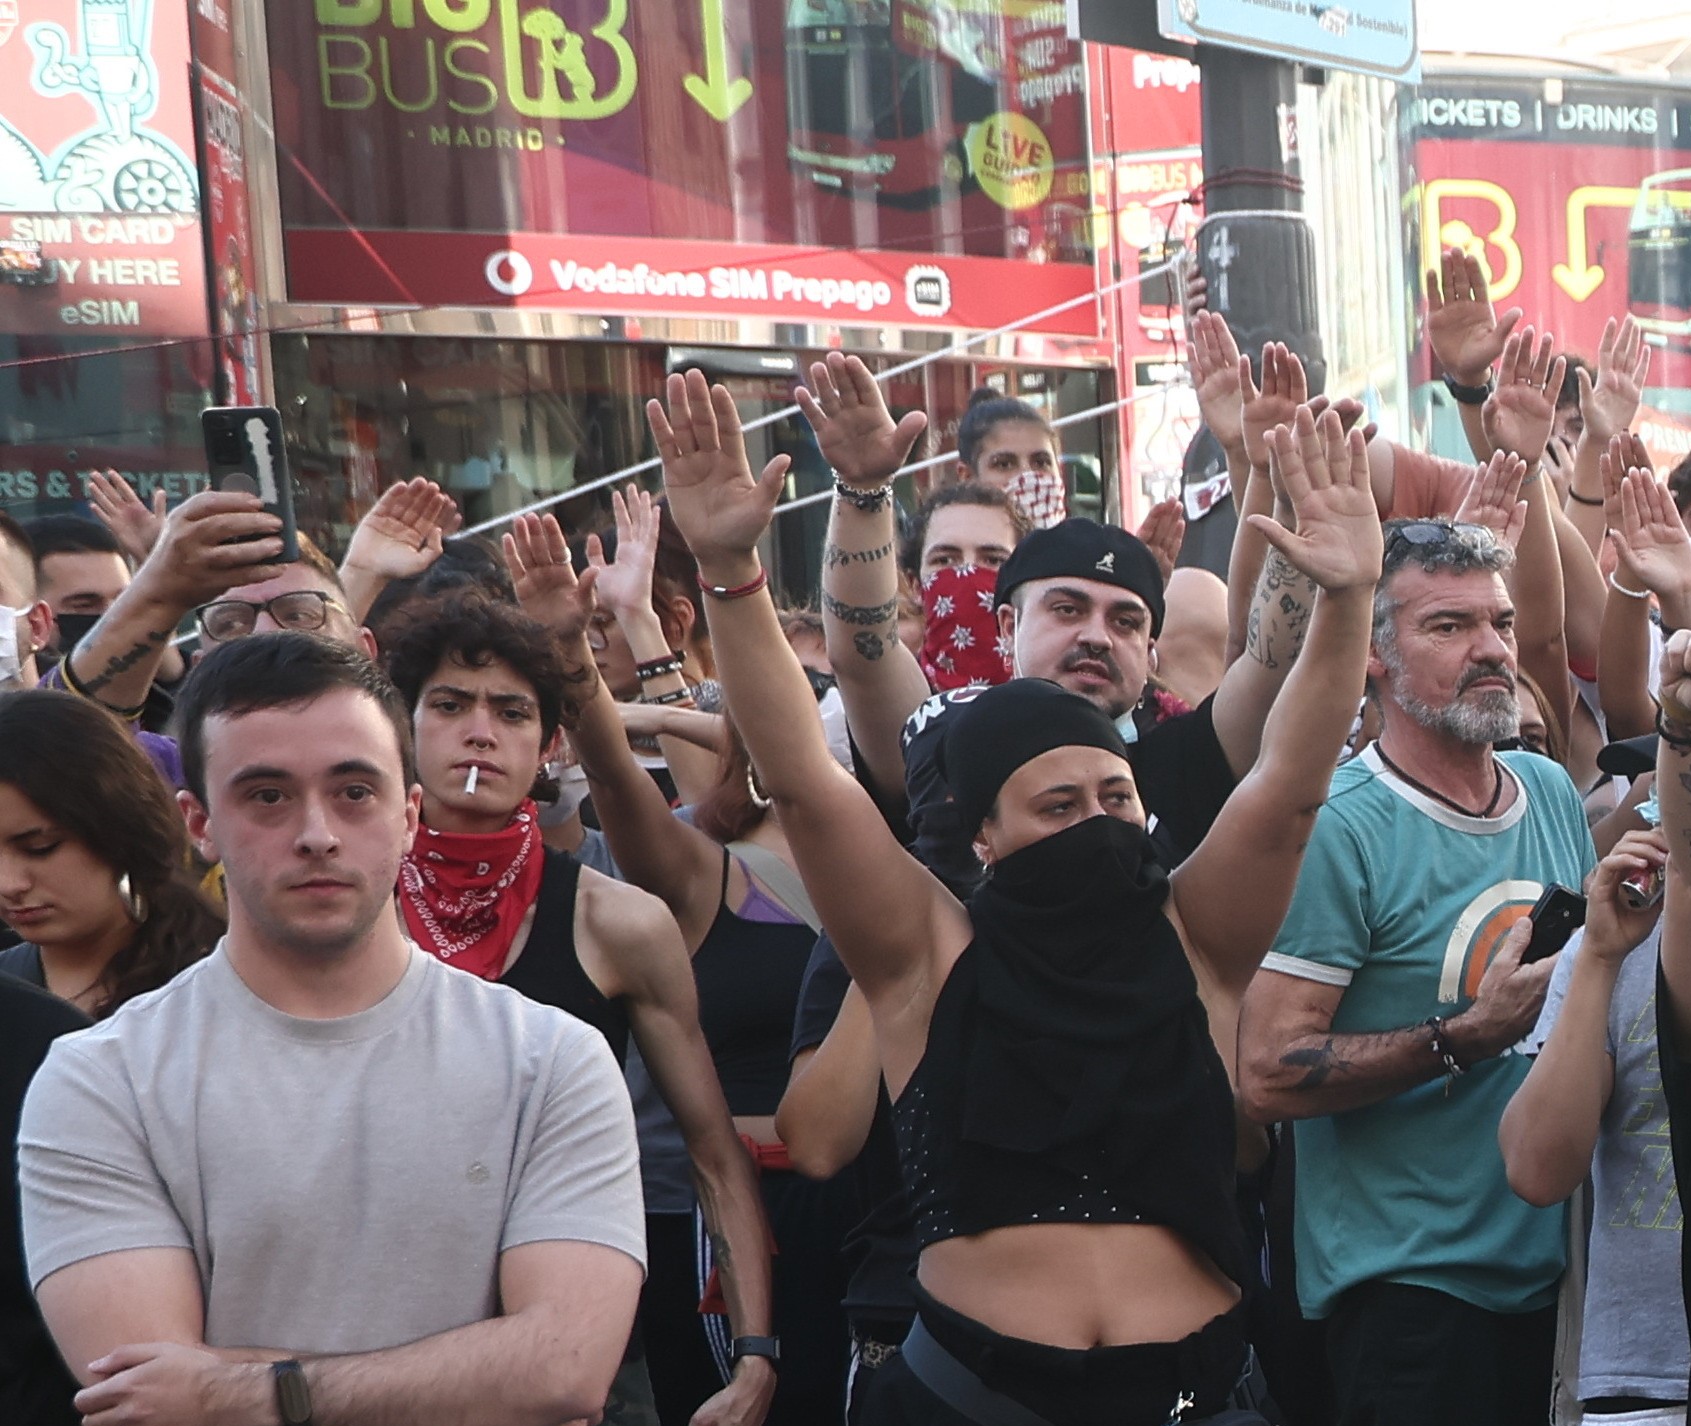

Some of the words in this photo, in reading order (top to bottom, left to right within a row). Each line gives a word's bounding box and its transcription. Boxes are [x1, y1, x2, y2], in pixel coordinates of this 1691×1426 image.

[319, 35, 499, 115] BUS
[1557, 103, 1659, 134] DRINKS
[430, 125, 544, 151] MADRID
[11, 218, 72, 243] SIM
[80, 216, 175, 245] CARD
[89, 258, 181, 286] HERE
[549, 259, 705, 298] Vodafone
[710, 267, 769, 300] SIM
[774, 271, 892, 312] Prepago
[60, 299, 140, 326] eSIM
[46, 470, 72, 499] &
